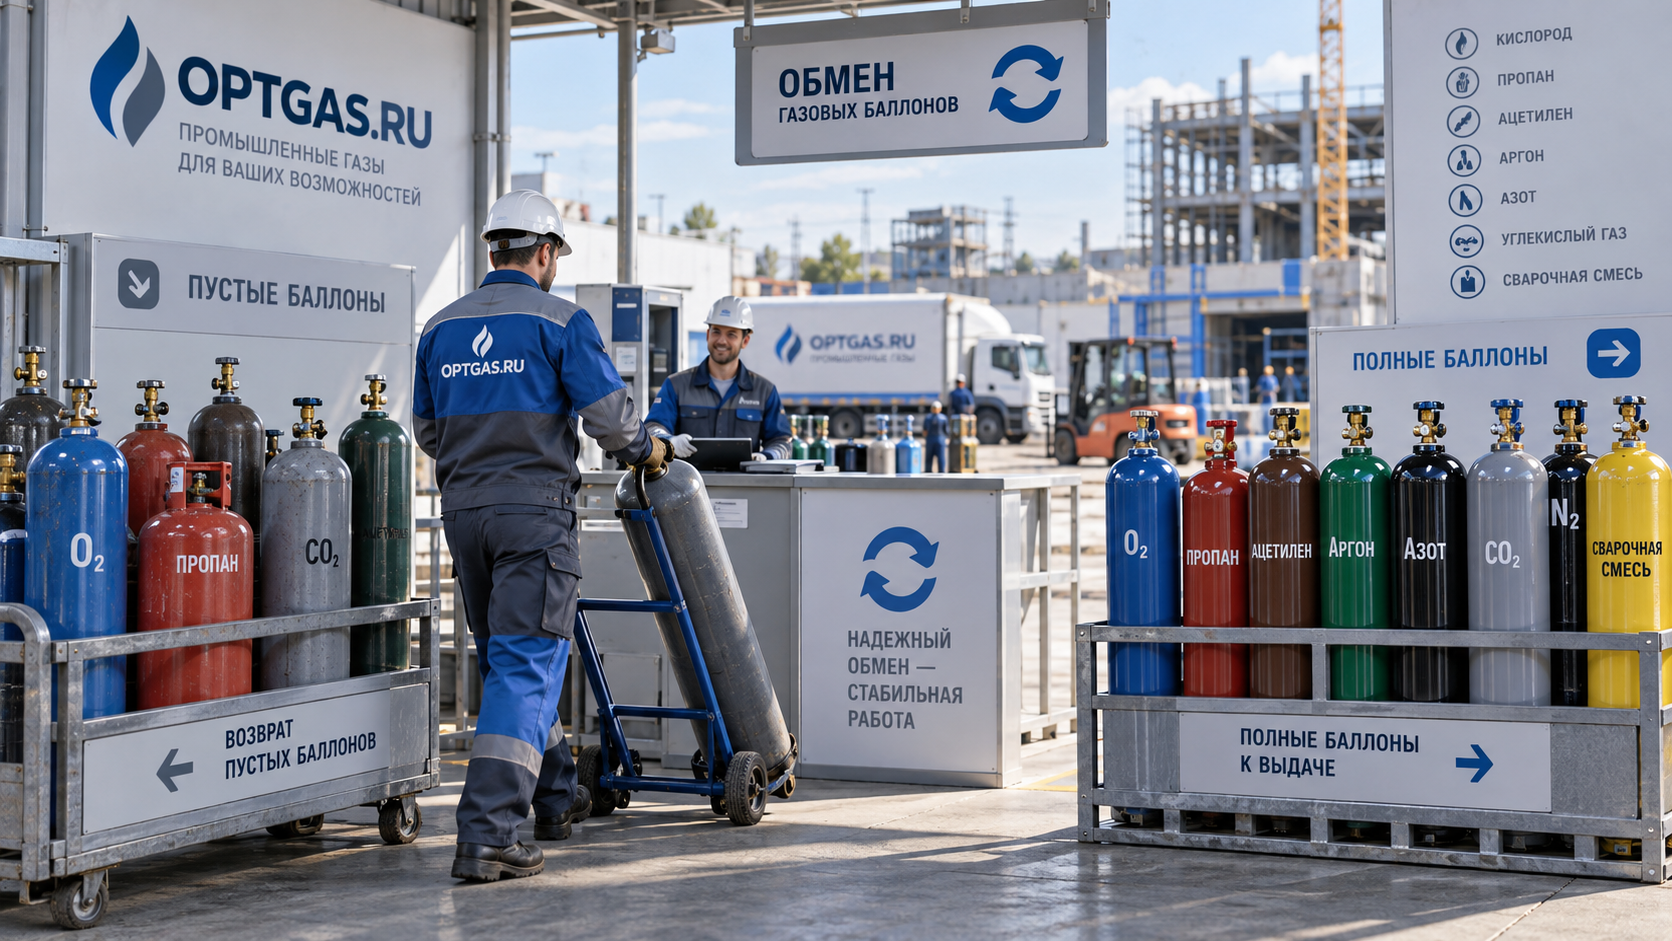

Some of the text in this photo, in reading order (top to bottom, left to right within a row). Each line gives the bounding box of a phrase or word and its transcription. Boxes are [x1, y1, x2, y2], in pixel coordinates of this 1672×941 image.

[1496, 26, 1573, 46] КИСЛОРОД
[778, 61, 894, 99] ОБМЕН
[1497, 69, 1555, 87] ПРОПАН
[178, 57, 432, 149] OPTGAS.RU
[779, 96, 959, 124] ГАЗОВЫХ БАЛЛОНОВ
[1498, 107, 1573, 126] АЦЕТИЛЕН
[179, 122, 385, 175] ПРОМЫШЛЕННЫЕ ГАЗЫ
[1499, 149, 1544, 165] АРГОН
[177, 151, 421, 207] ДЛЯ ВАШИХ ВОЗМОЖНОСТЕЙ
[1500, 190, 1537, 205] АЗОТ
[1501, 225, 1627, 247] УГЛЕКИСЛЫЙ ГАЗ
[1503, 266, 1643, 287] СВАРОЧНАЯ СМЕСЬ
[188, 274, 385, 314] ПУСТЫЕ БАЛЛОНЫ
[809, 333, 916, 350] OPTGAS.RU
[1353, 345, 1548, 371] ПОЛНЫЕ БАЛЛОНЫ
[441, 359, 525, 379] OPTGAS.RU
[1186, 549, 1239, 566] ПРОПАН
[1251, 543, 1312, 561] АЦЕТИЛЕН
[1592, 541, 1663, 556] СВАРОЧНАЯ
[176, 554, 239, 574] ПРОПАН
[1601, 561, 1651, 578] СМЕСЬ
[847, 627, 951, 651] НАДЕЖНЫЙ
[847, 656, 909, 676] ОБМЕН
[847, 683, 963, 704] СТАБИЛЬНАЯ
[848, 709, 915, 730] РАБОТА
[225, 719, 294, 749] ВОЗВРАТ
[1240, 727, 1419, 753] ПОЛНЫЕ БАЛЛОНЫ
[225, 731, 377, 780] ПУСТЫХ БАЛЛОНОВ
[1240, 754, 1336, 779] К ВЫДАЧЕ
